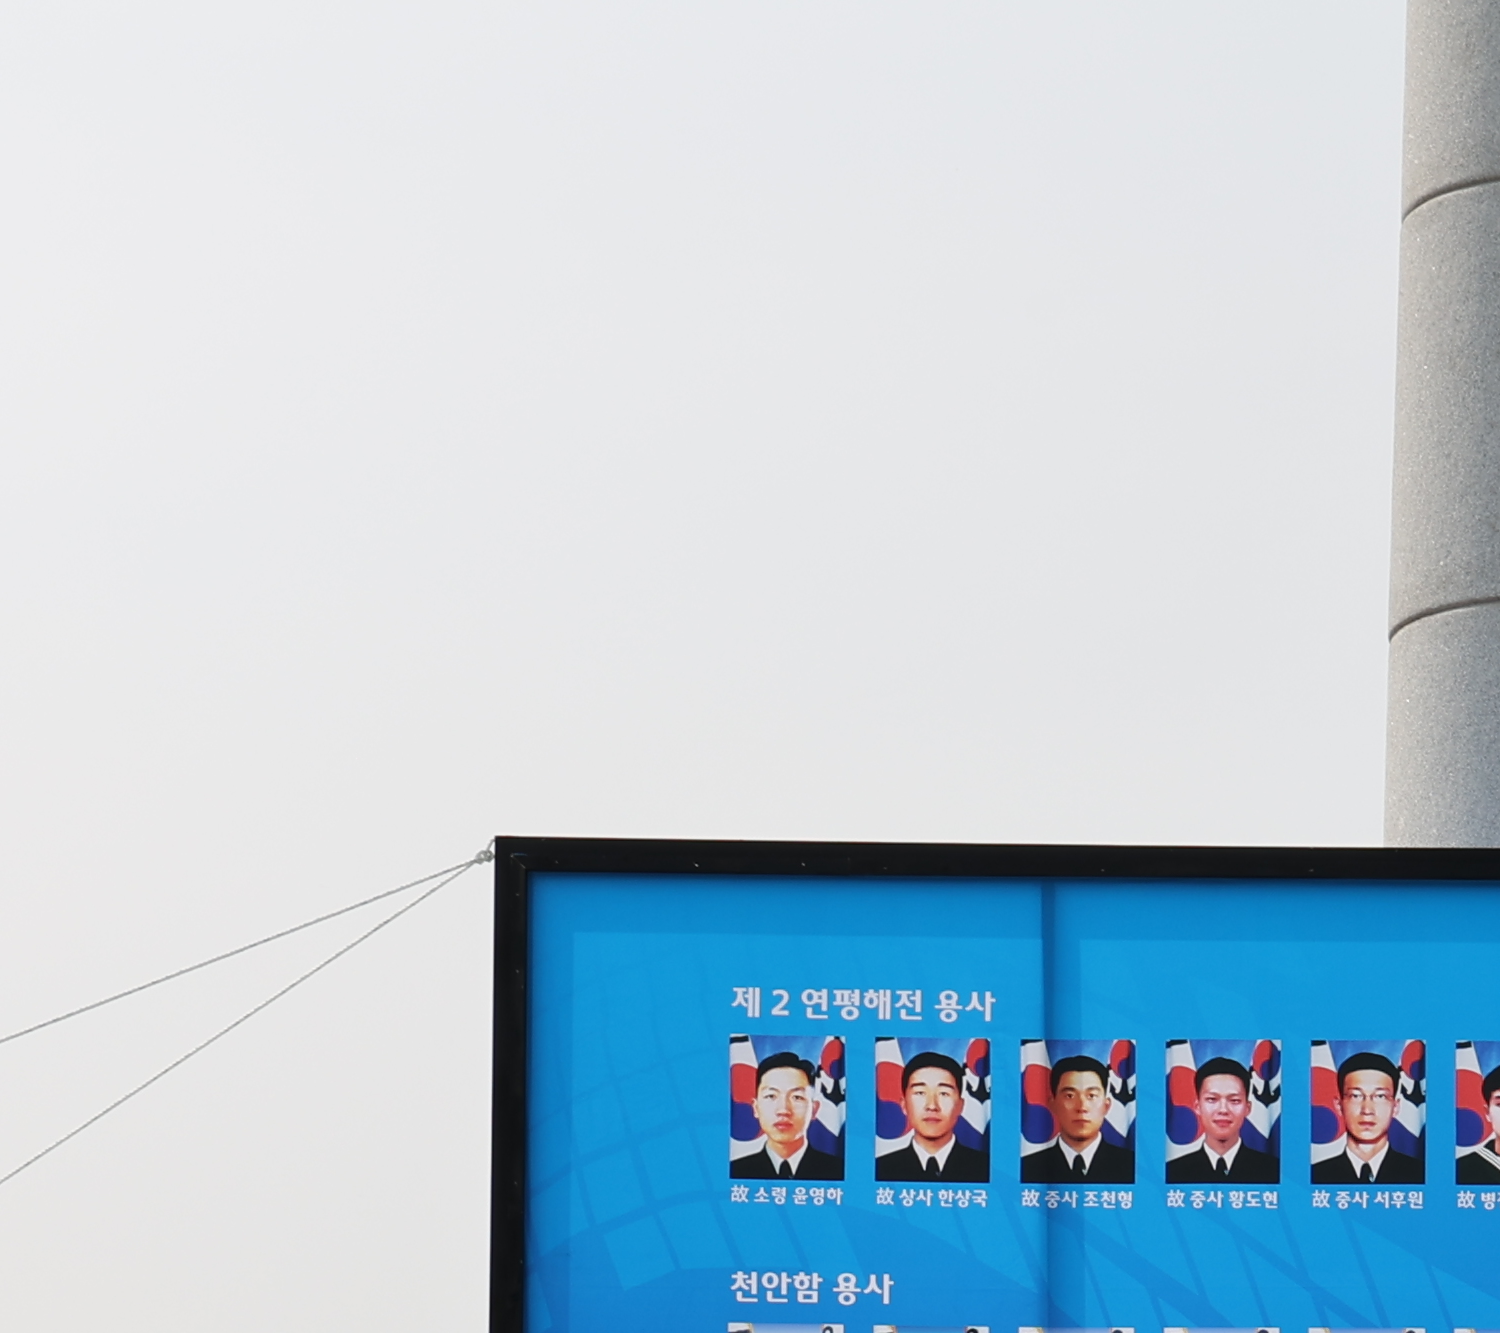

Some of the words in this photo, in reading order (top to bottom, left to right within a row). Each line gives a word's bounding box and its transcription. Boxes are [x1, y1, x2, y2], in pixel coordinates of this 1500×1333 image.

[731, 986, 761, 1019] 제
[770, 988, 790, 1017] 2
[800, 988, 923, 1021] 연평해전
[933, 989, 997, 1024] 용사
[730, 1184, 750, 1203] 故
[753, 1186, 787, 1206] 소령
[792, 1186, 844, 1206] 윤영하
[875, 1186, 895, 1206] 故
[898, 1188, 934, 1208] 상사
[937, 1188, 988, 1209] 한상국
[1021, 1188, 1041, 1208] 故
[1044, 1190, 1079, 1209] 중사
[1083, 1190, 1133, 1210] 조천형
[1166, 1189, 1186, 1208] 故
[1189, 1190, 1225, 1210] 중사
[1228, 1190, 1278, 1210] 황도현
[1311, 1189, 1331, 1209] 故
[1334, 1190, 1370, 1210] 중사
[1373, 1190, 1424, 1210] 서후원
[1456, 1190, 1476, 1209] 故
[730, 1270, 824, 1304] 천안함
[832, 1272, 895, 1306] 용사
